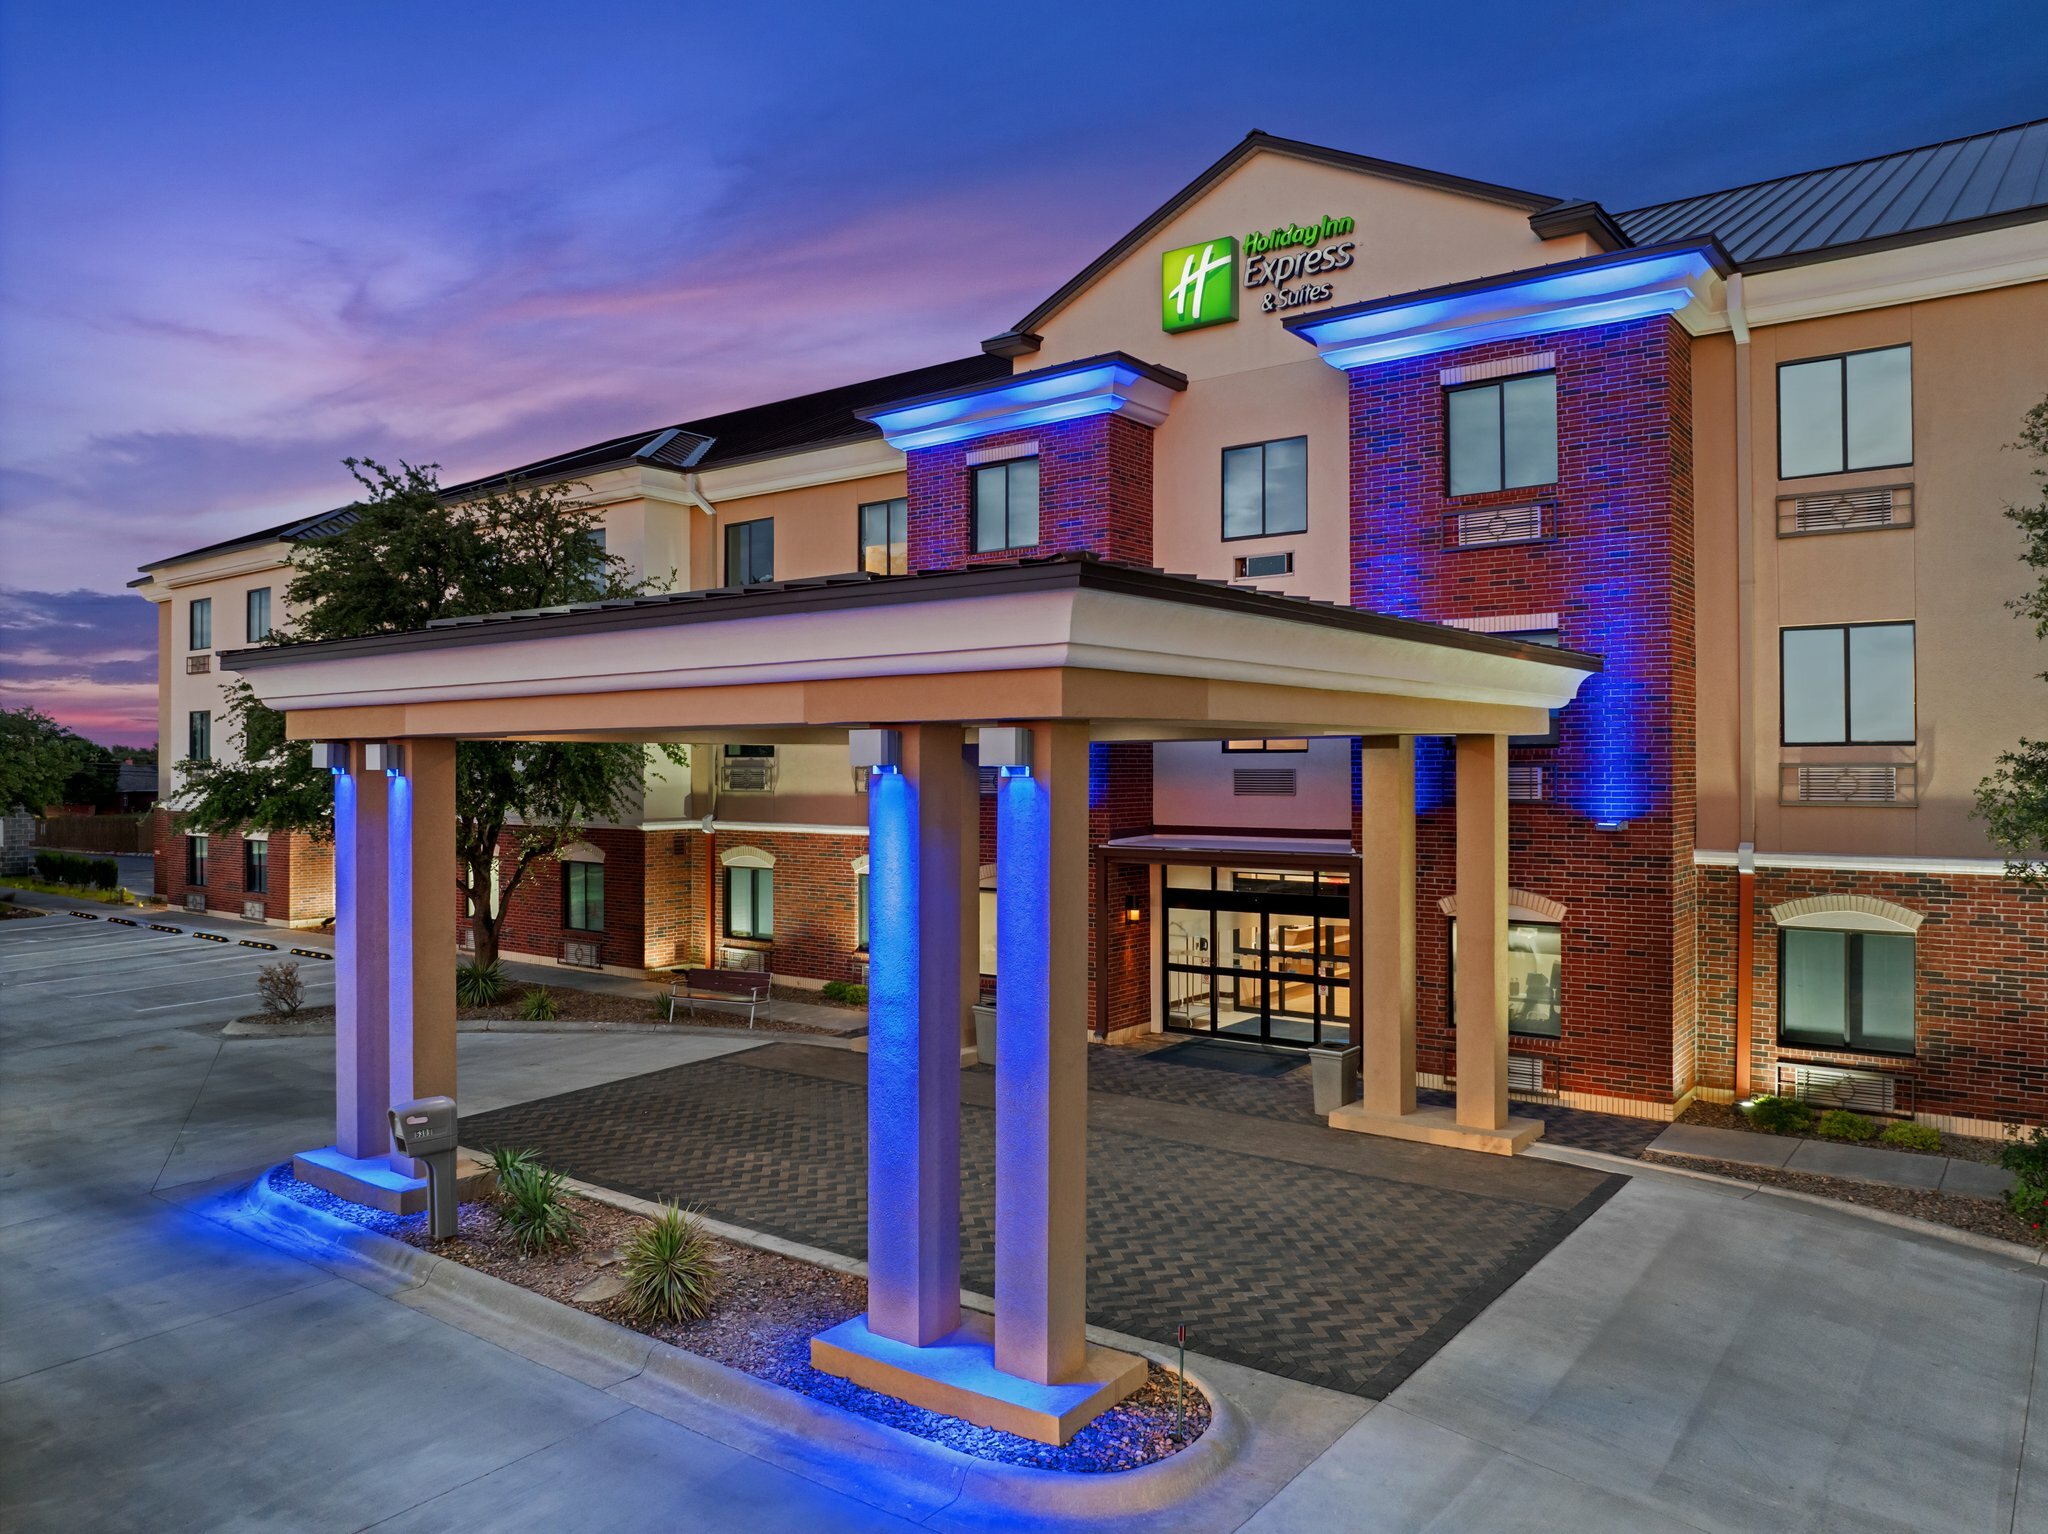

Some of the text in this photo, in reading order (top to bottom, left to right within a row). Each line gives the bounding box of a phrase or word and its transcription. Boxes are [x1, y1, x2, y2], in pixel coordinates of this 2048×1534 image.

[1243, 215, 1354, 255] Holiday Inn
[1243, 242, 1355, 289] Express
[1261, 283, 1333, 312] & Suites
